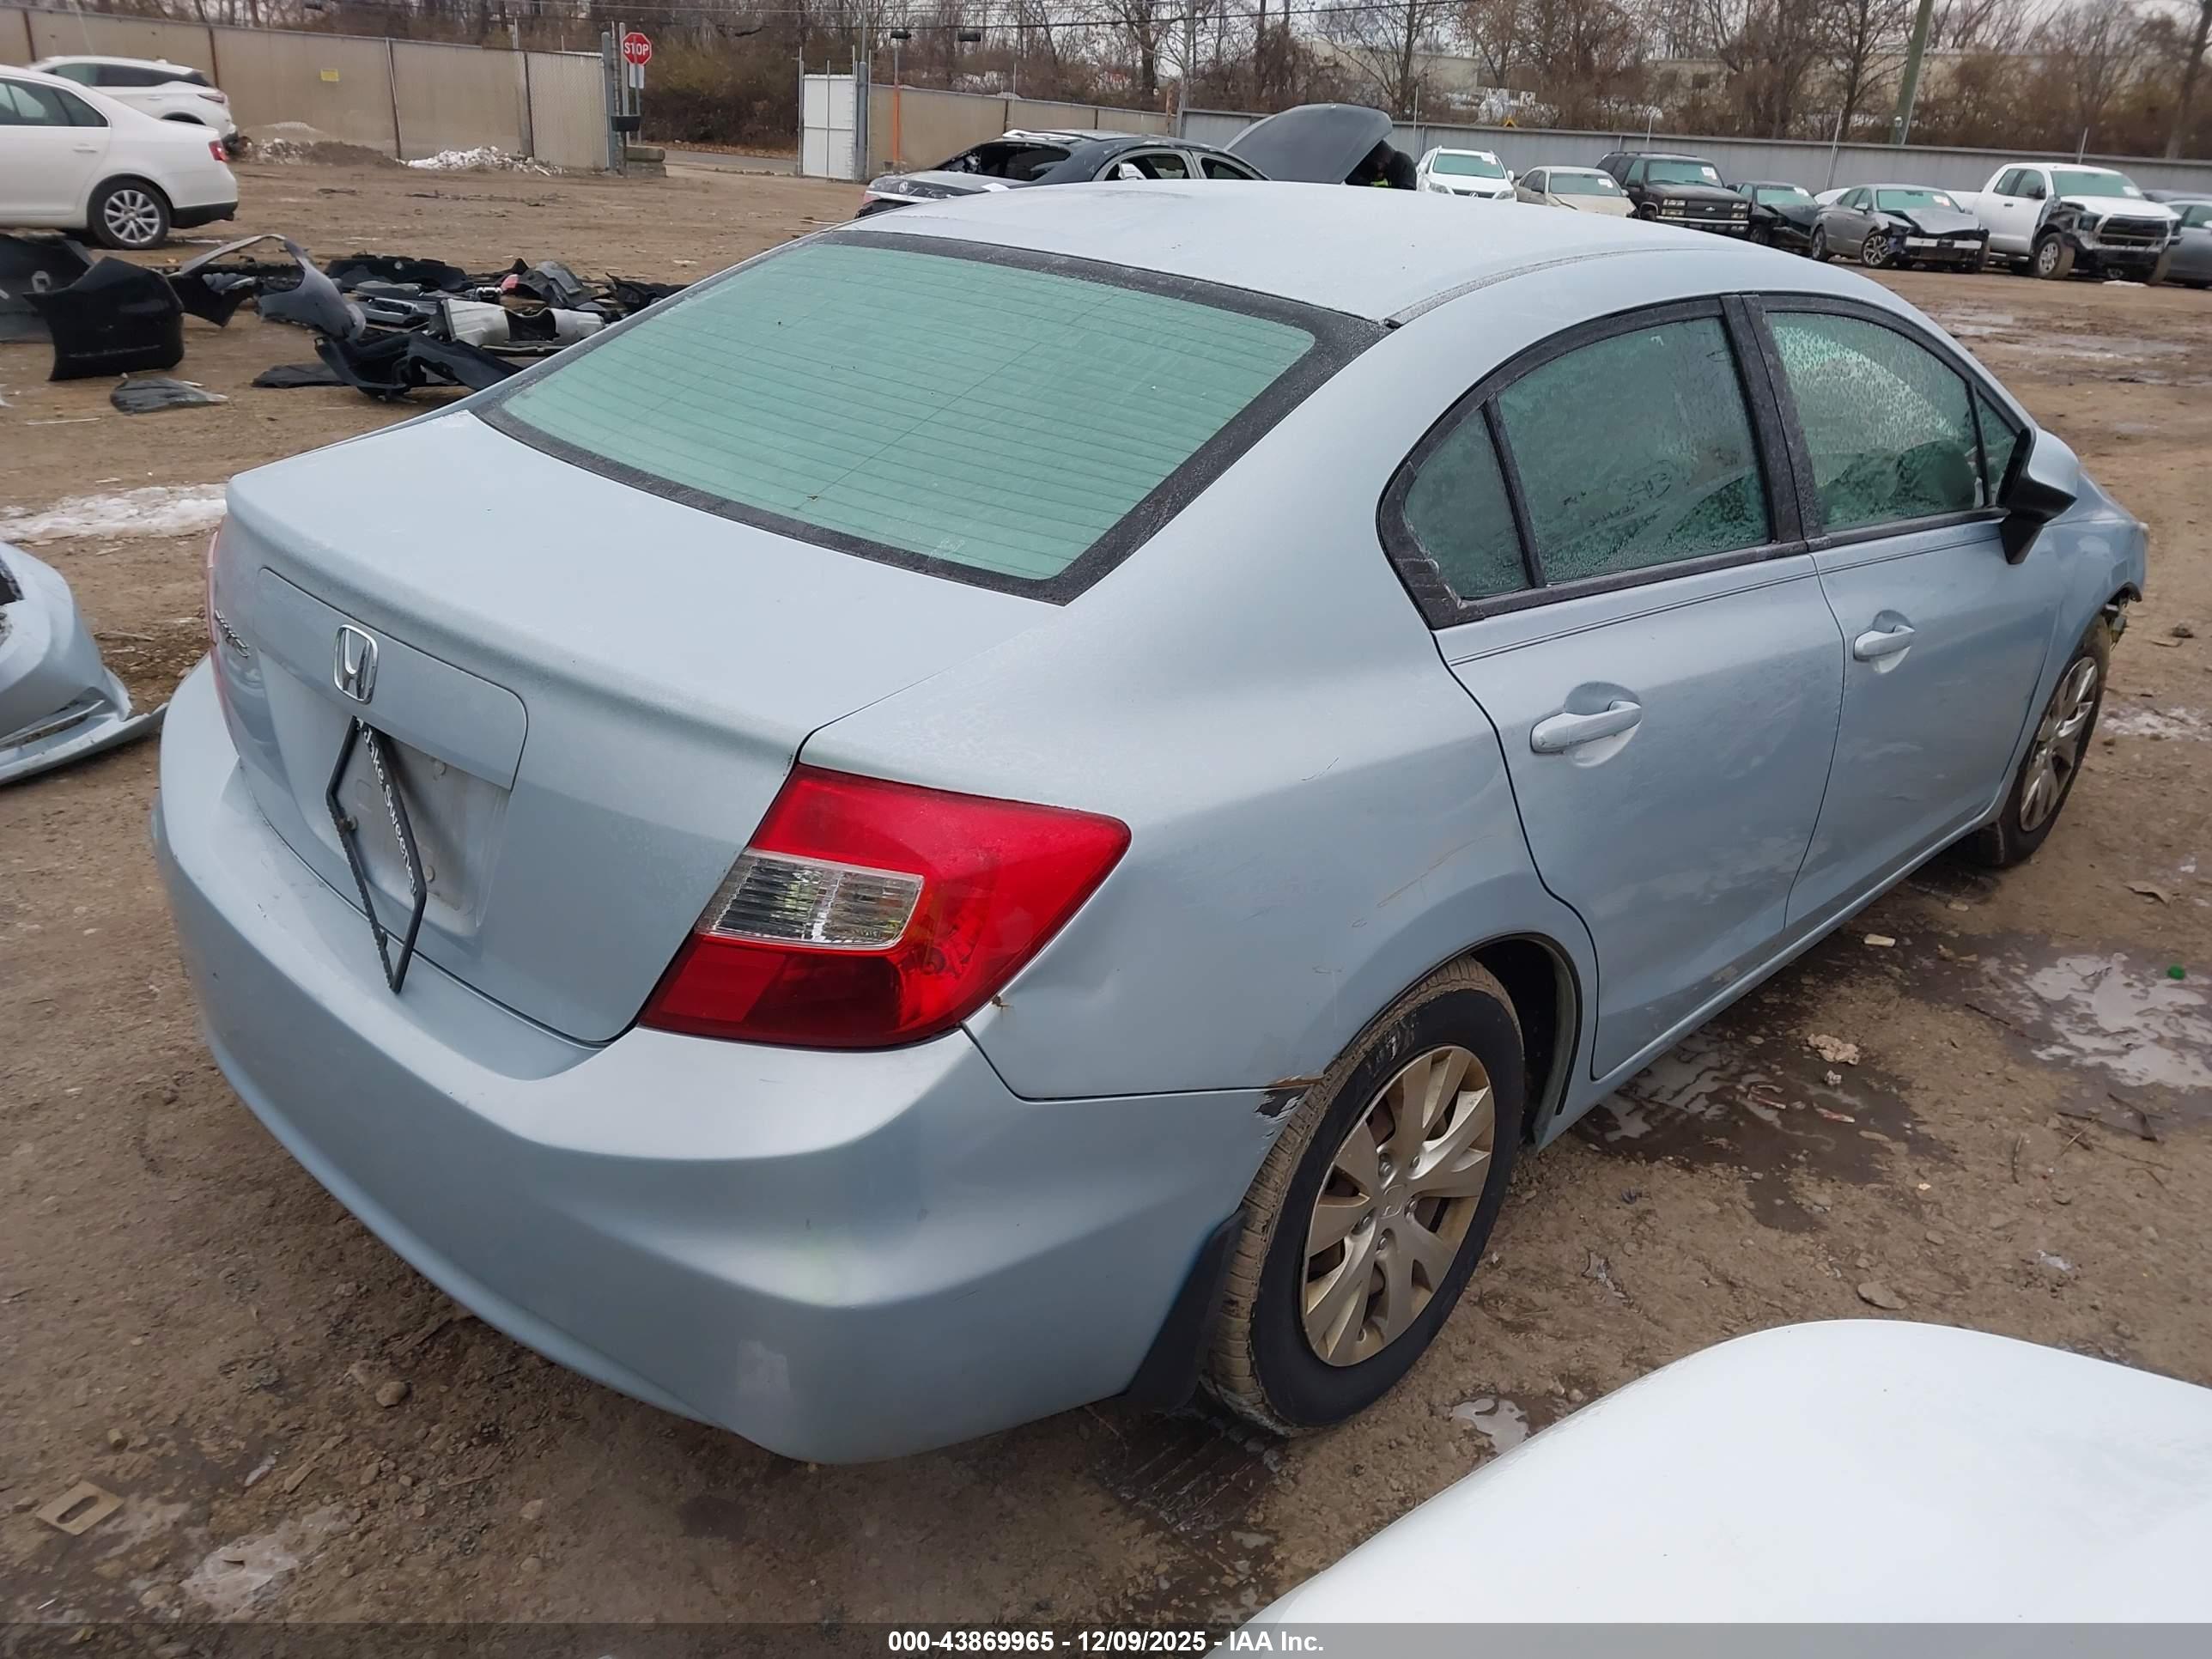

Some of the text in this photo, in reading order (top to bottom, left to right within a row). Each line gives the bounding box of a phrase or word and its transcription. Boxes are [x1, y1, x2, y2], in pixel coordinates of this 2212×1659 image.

[624, 42, 649, 56] STOP
[363, 727, 416, 895] Jake Sweeney
